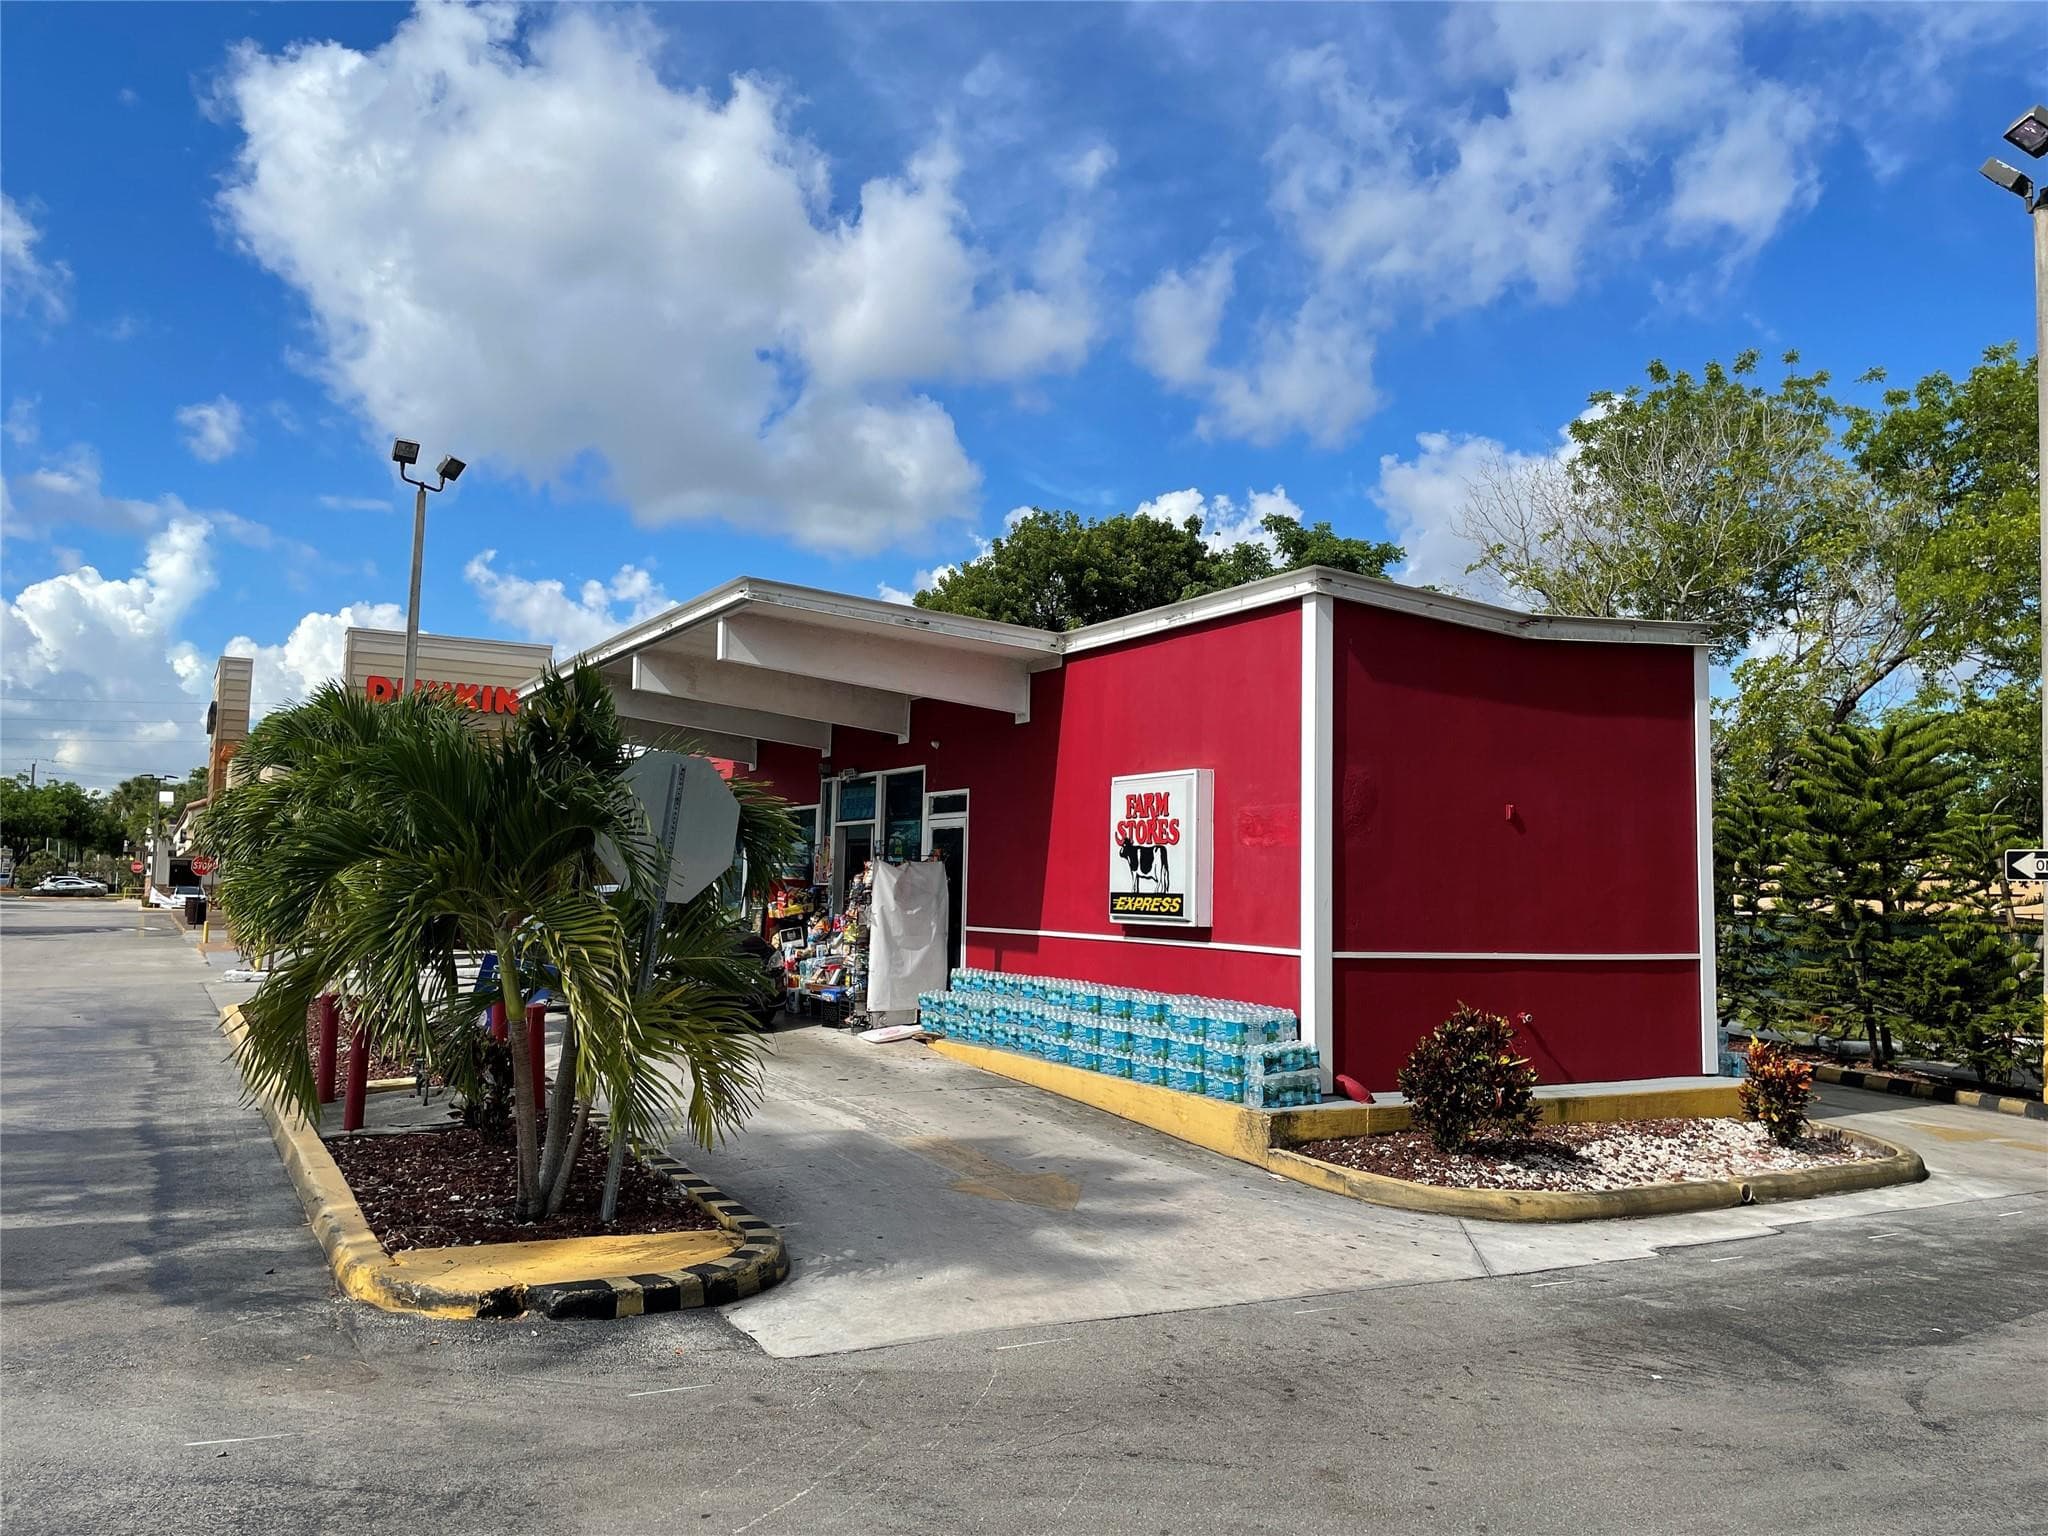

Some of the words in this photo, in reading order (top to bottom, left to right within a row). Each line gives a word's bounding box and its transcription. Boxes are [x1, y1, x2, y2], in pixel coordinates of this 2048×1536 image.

[366, 675, 521, 715] DKIN
[1126, 792, 1170, 819] FARM
[1115, 818, 1180, 846] STORES
[2036, 860, 2048, 871] O
[1114, 897, 1181, 912] EXPRESS
